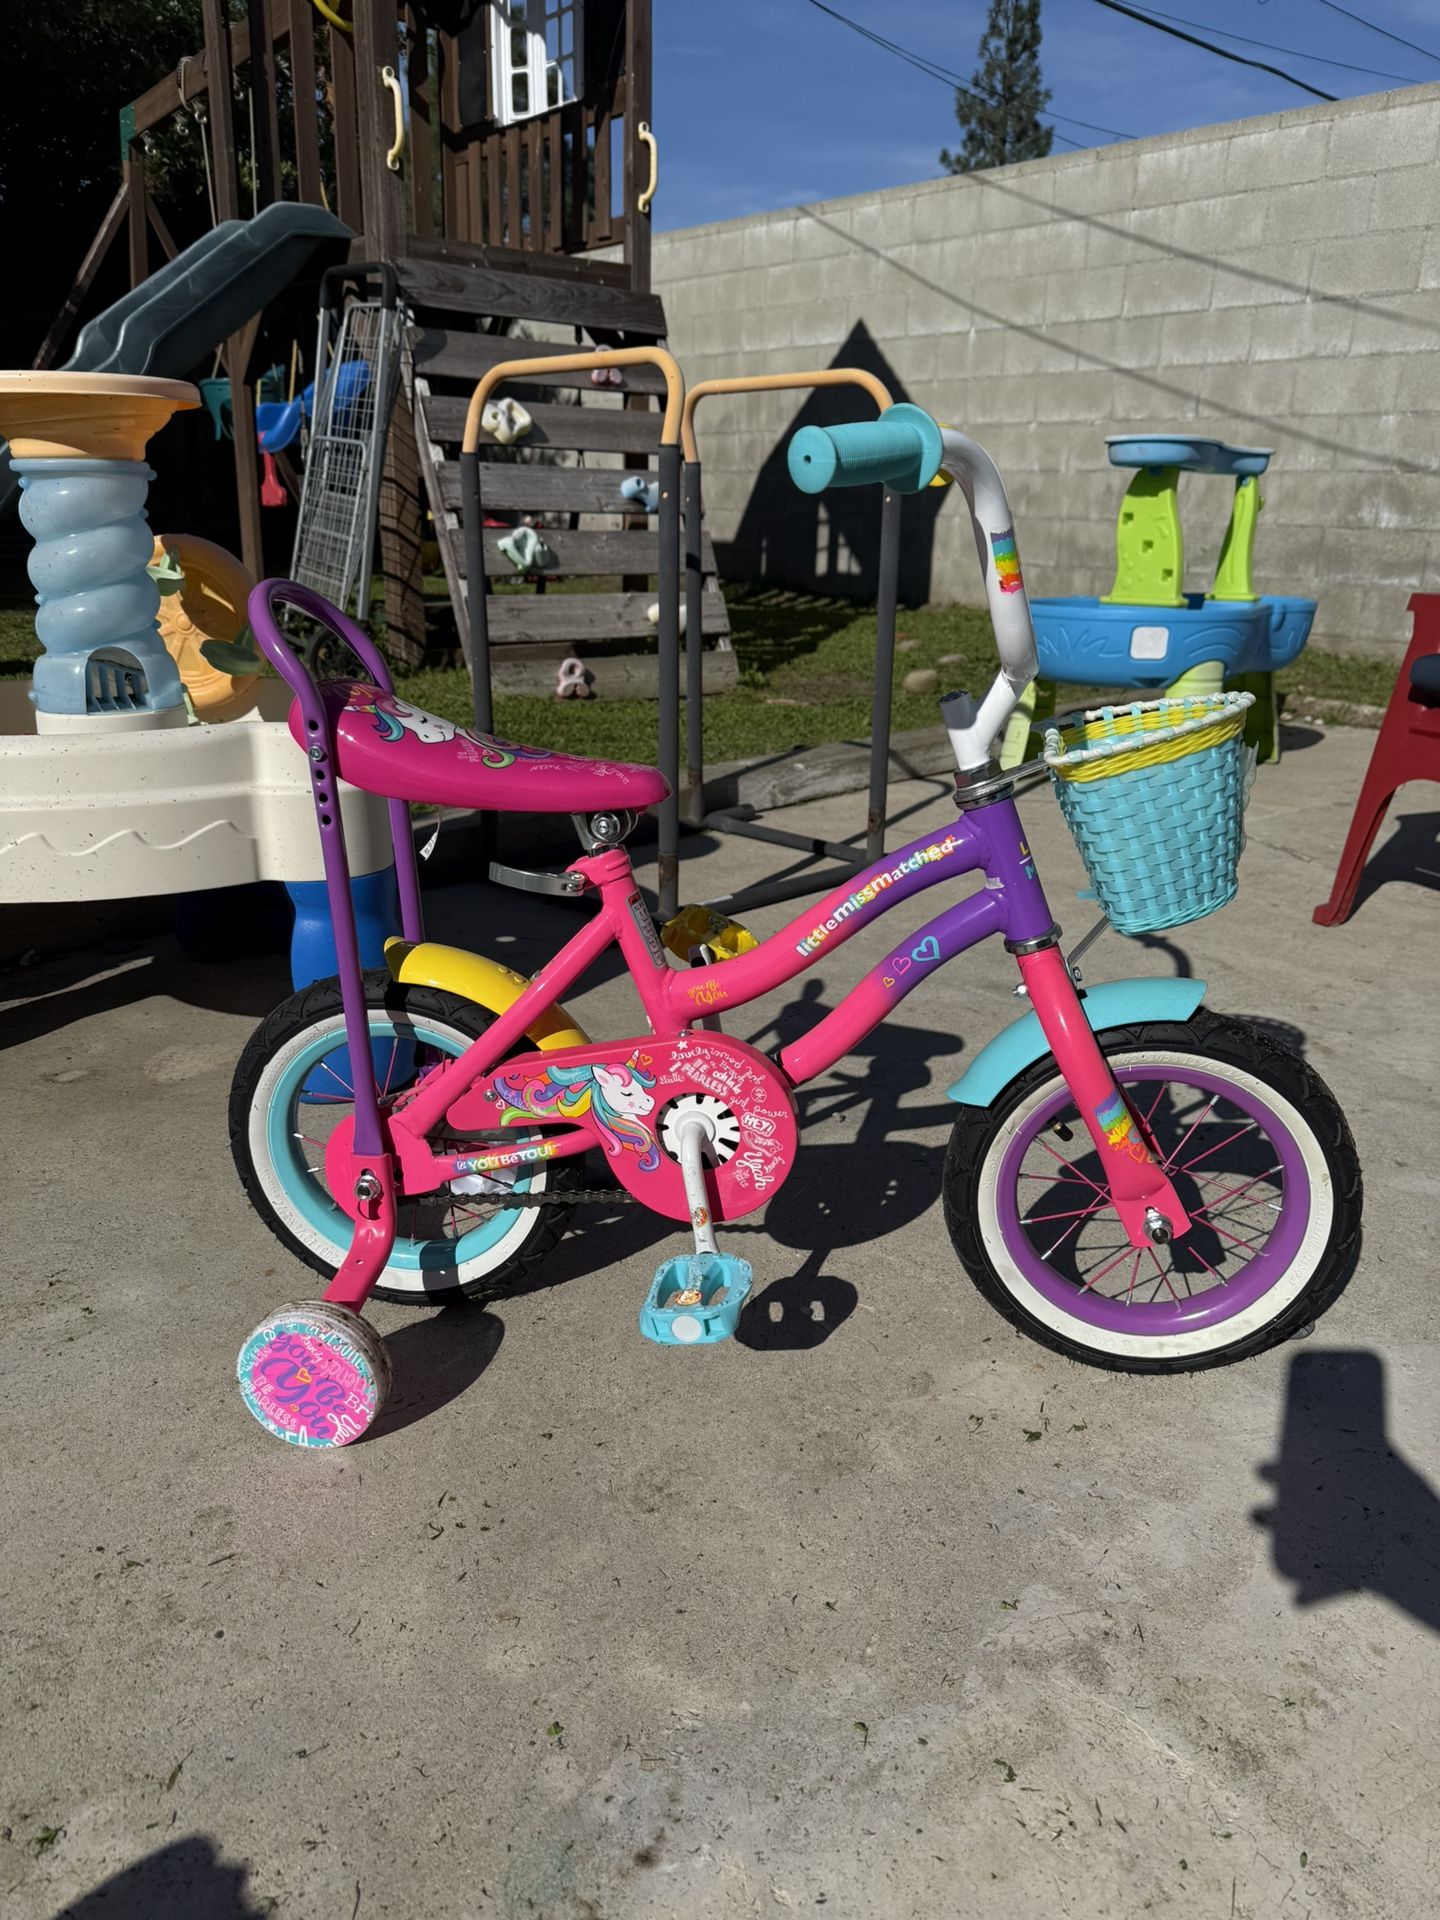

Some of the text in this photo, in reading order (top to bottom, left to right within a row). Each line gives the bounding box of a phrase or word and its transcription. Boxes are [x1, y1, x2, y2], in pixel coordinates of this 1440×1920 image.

[796, 836, 955, 957] littlemissmatched
[682, 1063, 729, 1097] FEARLESS
[728, 1096, 788, 1119] girl power
[253, 1375, 275, 1395] BE
[241, 1378, 298, 1431] FEARLESS
